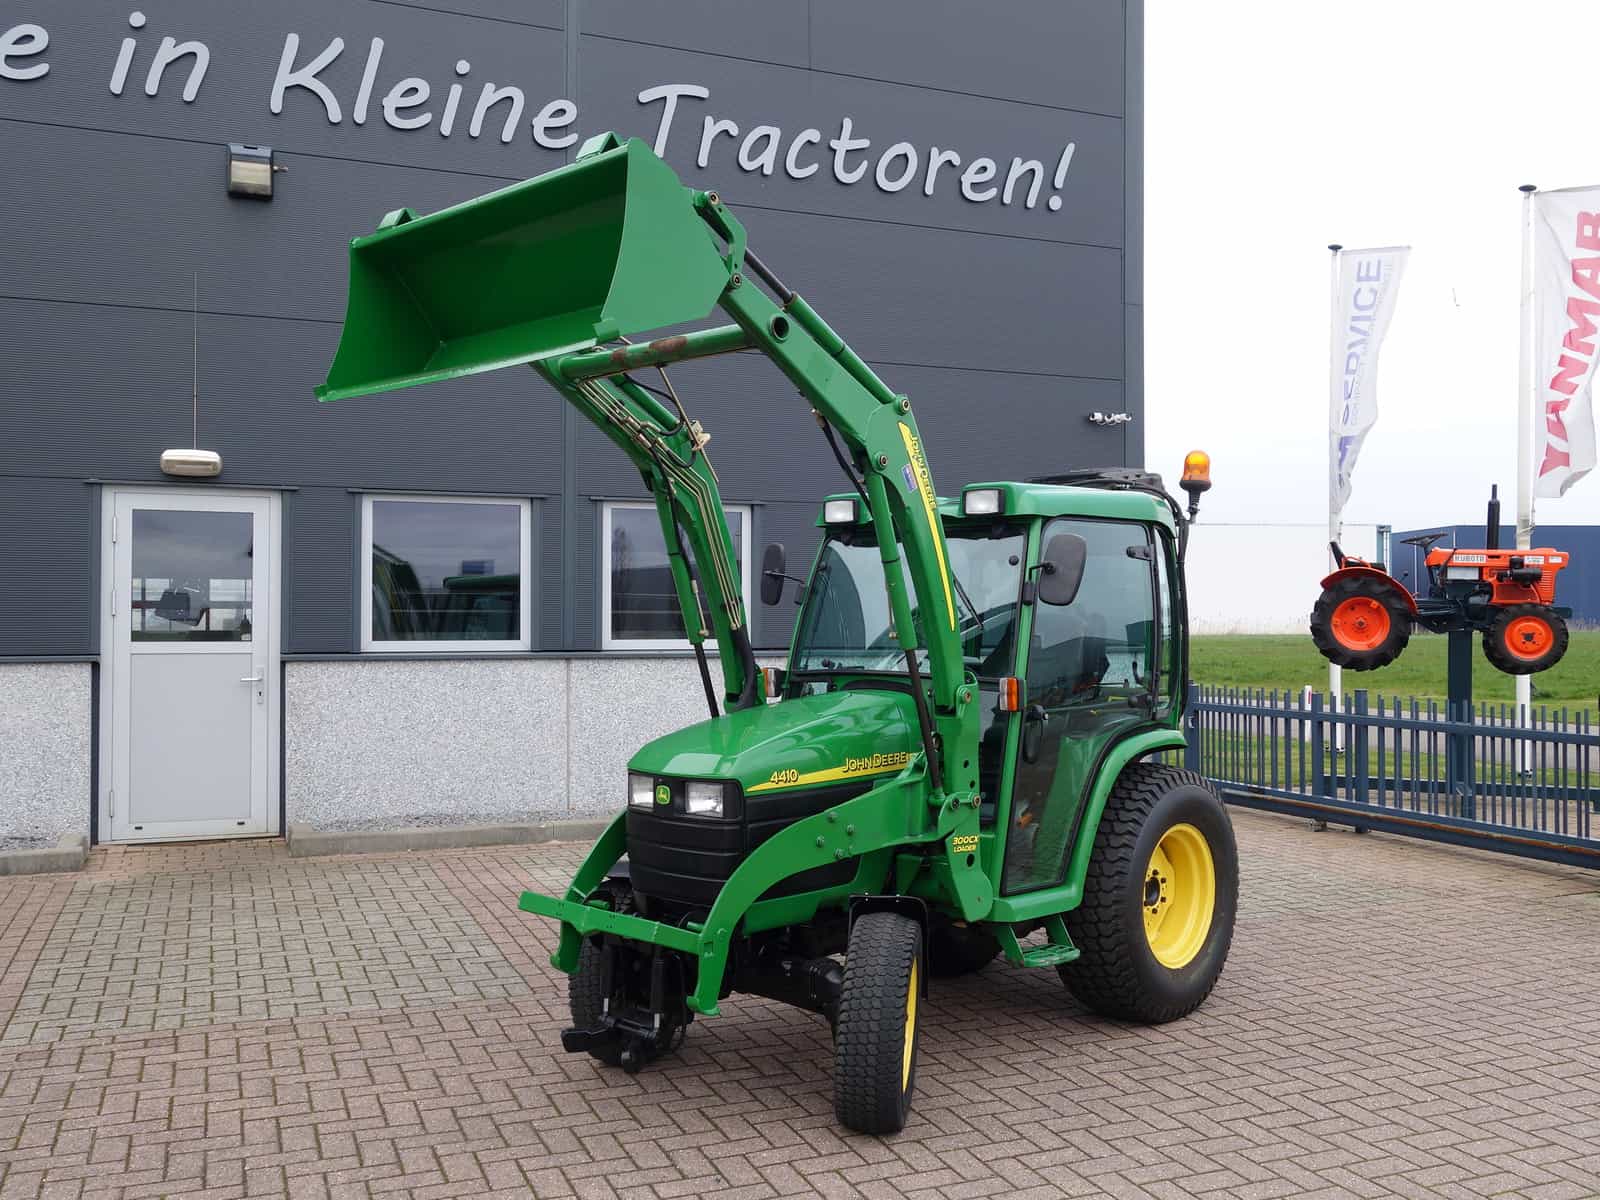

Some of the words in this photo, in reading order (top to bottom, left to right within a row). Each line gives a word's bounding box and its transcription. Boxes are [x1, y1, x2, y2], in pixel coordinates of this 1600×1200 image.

[0, 24, 50, 80] e
[109, 11, 210, 102] in
[269, 33, 578, 149] Kleine
[638, 83, 1075, 211] Tractoren!
[843, 757, 873, 772] JOHN
[873, 752, 907, 768] DEERE
[769, 769, 798, 784] 4410
[952, 836, 979, 845] 300CX
[953, 845, 977, 853] LOADER
